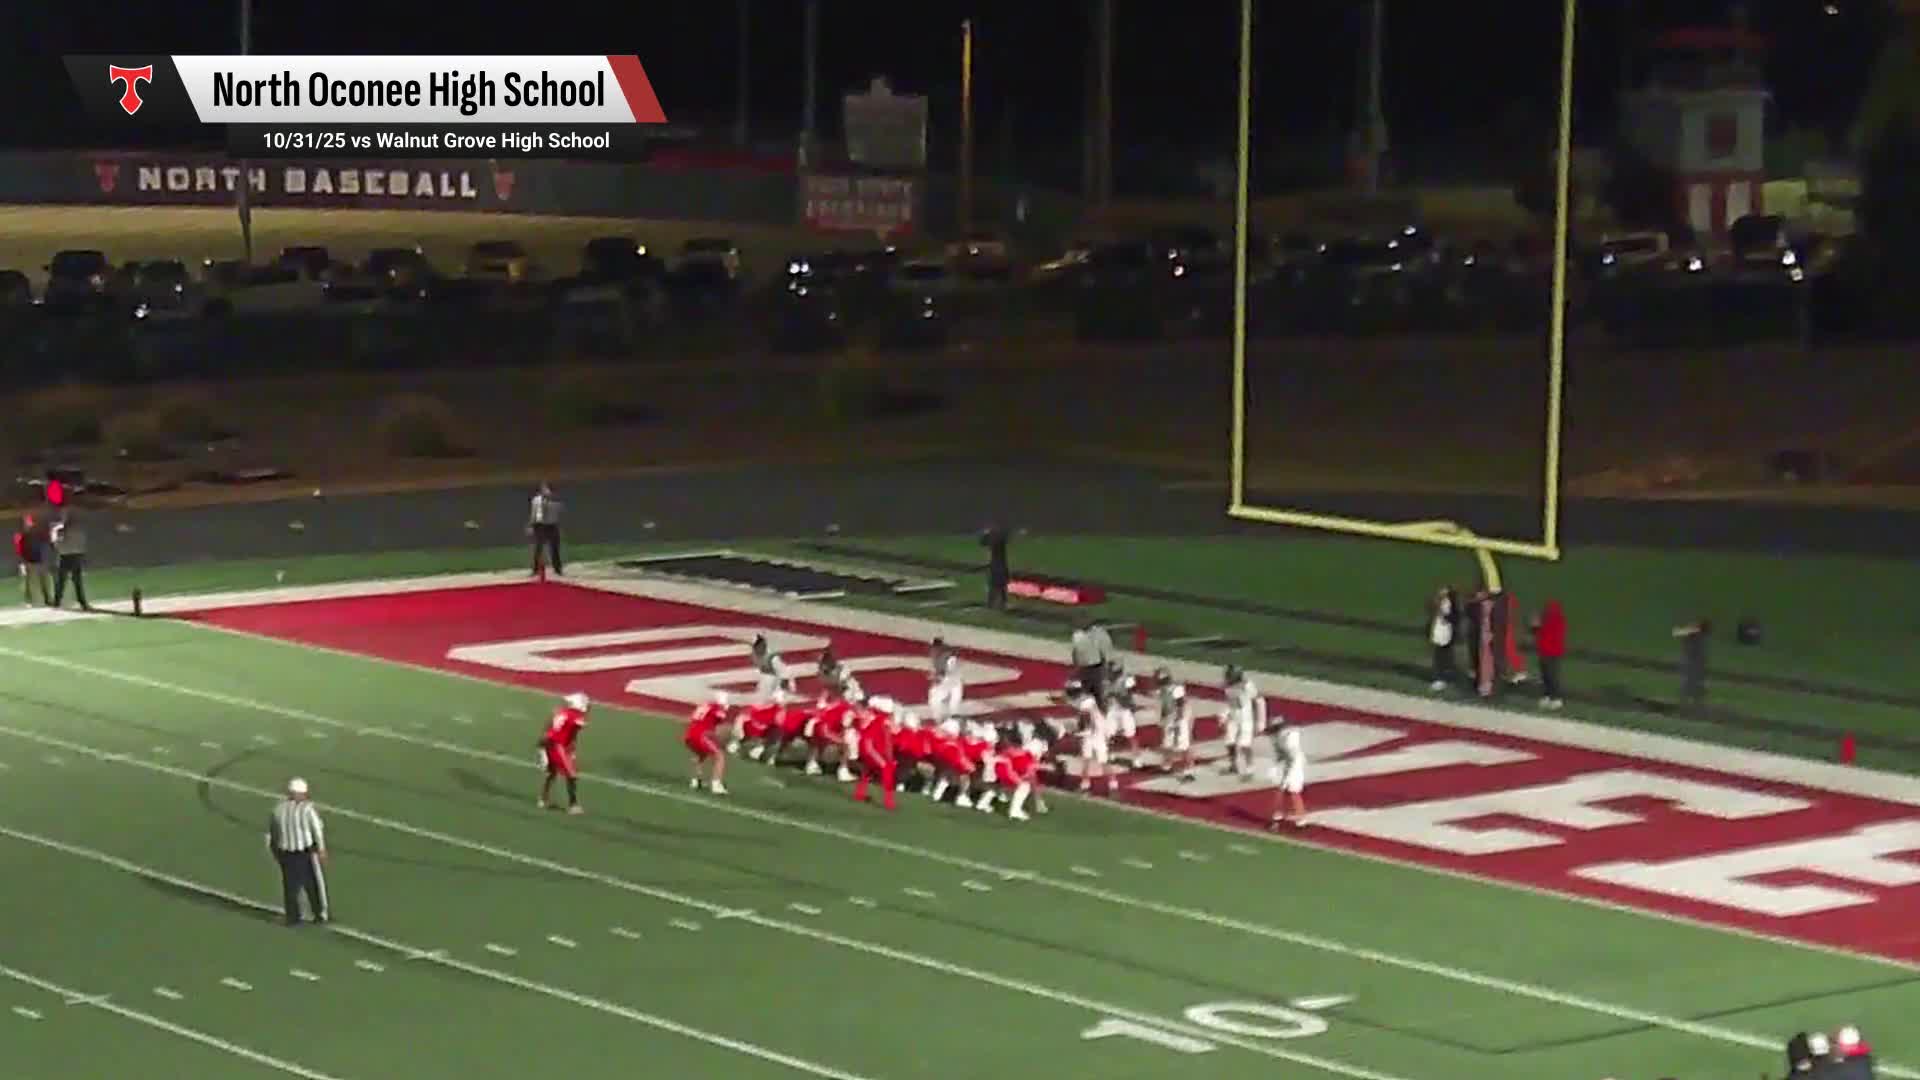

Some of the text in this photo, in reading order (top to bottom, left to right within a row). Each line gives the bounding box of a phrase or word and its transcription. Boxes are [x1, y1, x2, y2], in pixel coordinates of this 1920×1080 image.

[138, 166, 478, 199] NORTH BASEBALL
[1080, 1001, 1329, 1054] 10
